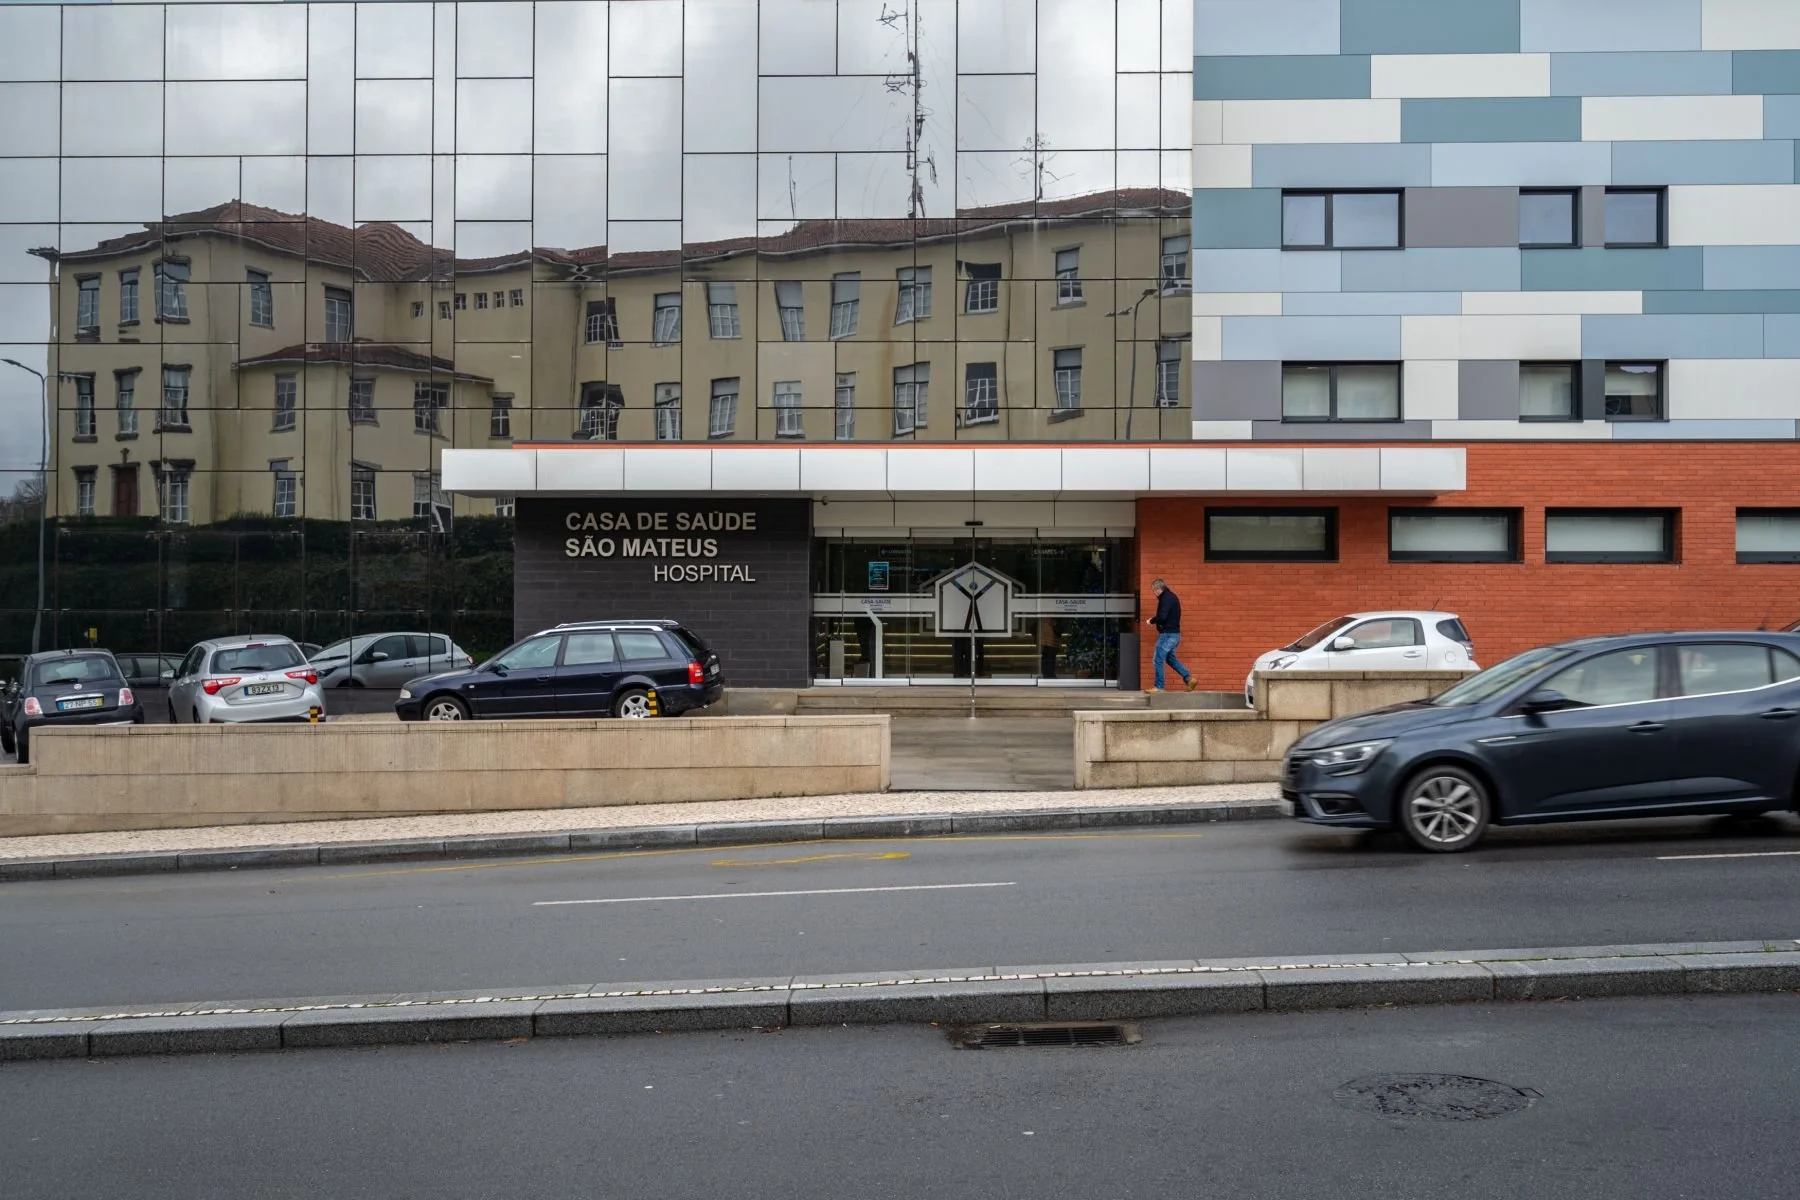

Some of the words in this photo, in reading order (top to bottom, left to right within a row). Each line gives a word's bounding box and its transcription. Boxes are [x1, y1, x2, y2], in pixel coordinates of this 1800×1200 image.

[565, 512, 631, 531] CASA
[637, 512, 668, 531] DE
[676, 510, 757, 531] SAÚDE
[565, 535, 616, 557] SÃO
[622, 538, 718, 557] MATEUS
[654, 564, 756, 582] HOSPITAL
